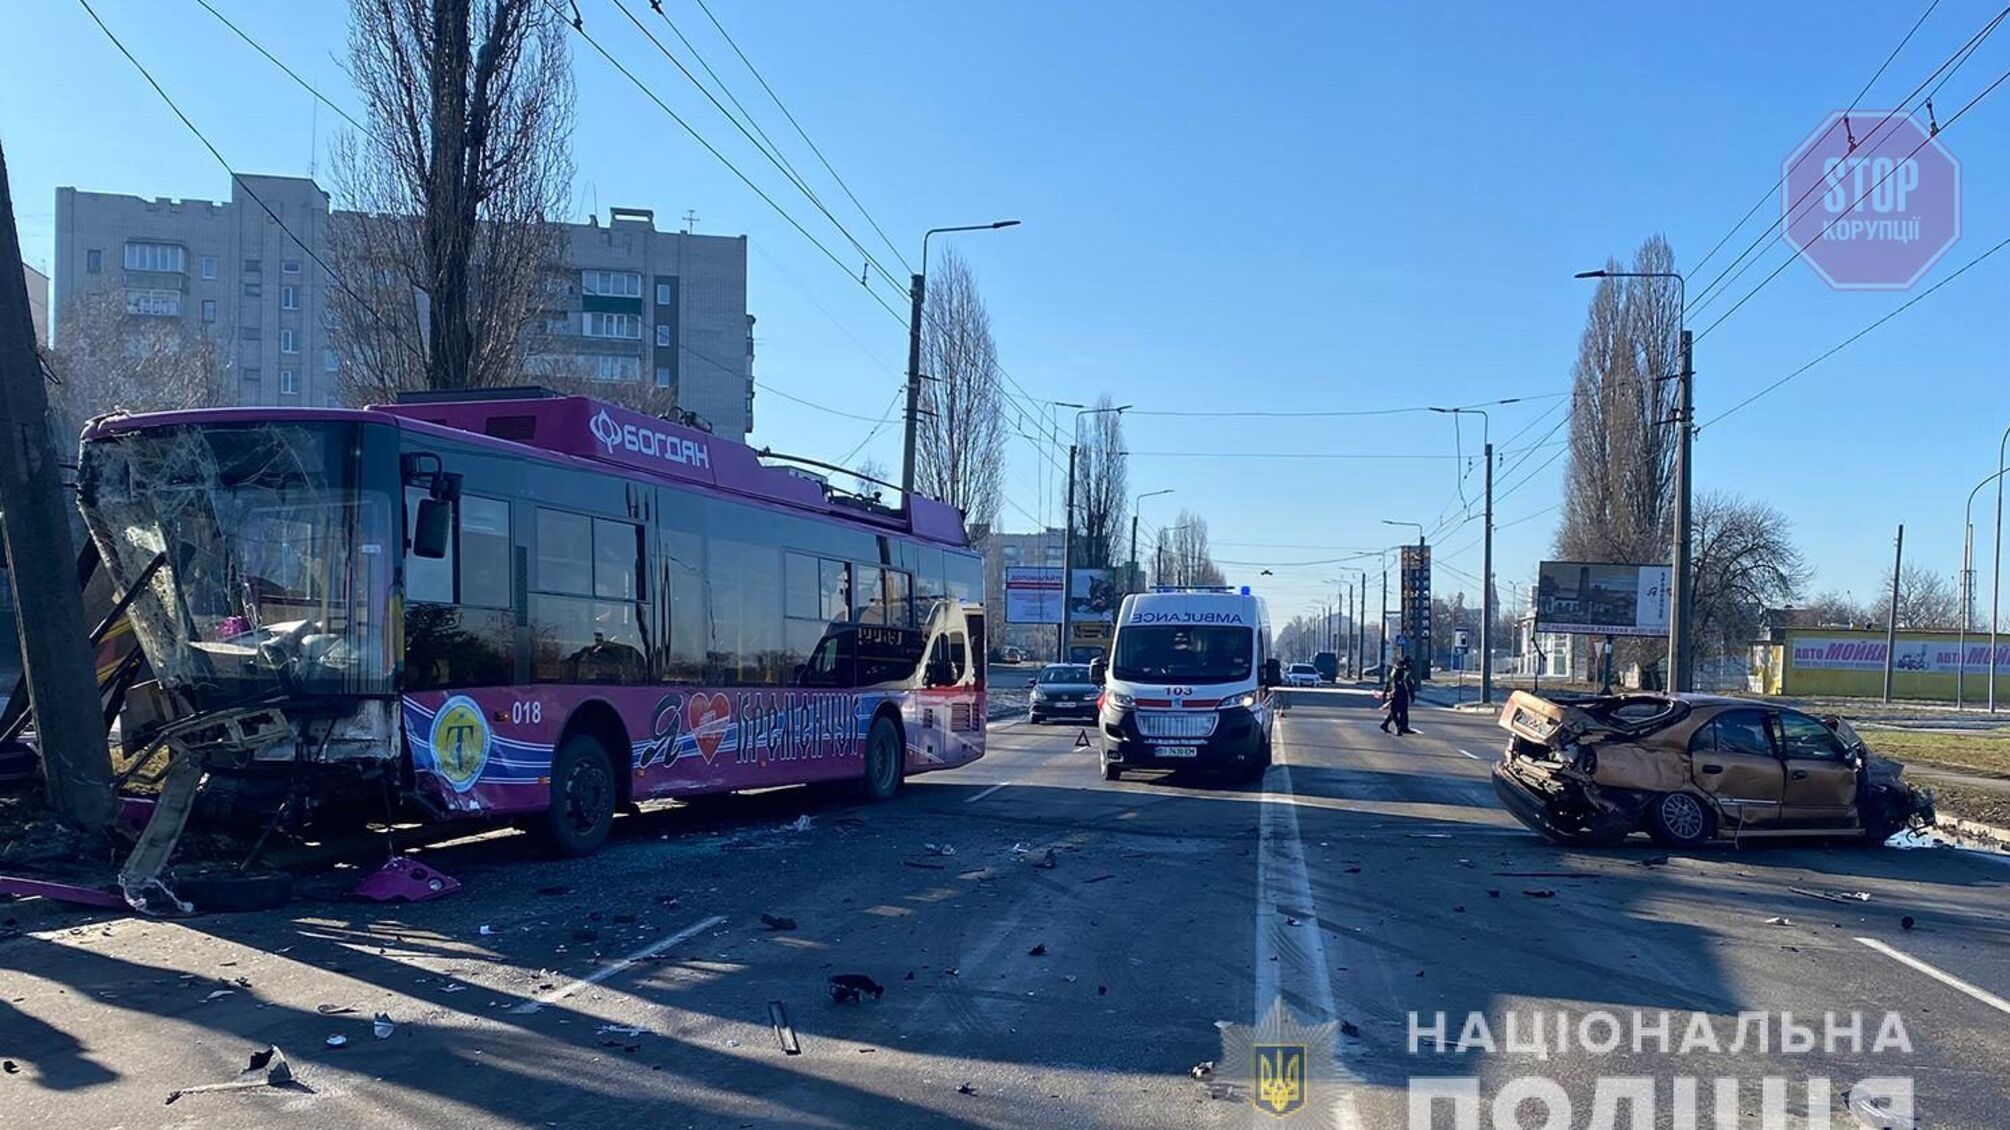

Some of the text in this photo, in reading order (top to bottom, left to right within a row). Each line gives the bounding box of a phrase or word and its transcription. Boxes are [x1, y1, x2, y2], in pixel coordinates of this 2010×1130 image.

[623, 424, 710, 469] БОГДАН
[1795, 641, 1888, 661] АВТО МОЙКА
[1967, 644, 2010, 665] МОЙ
[1165, 687, 1193, 696] 103
[512, 701, 541, 724] 018
